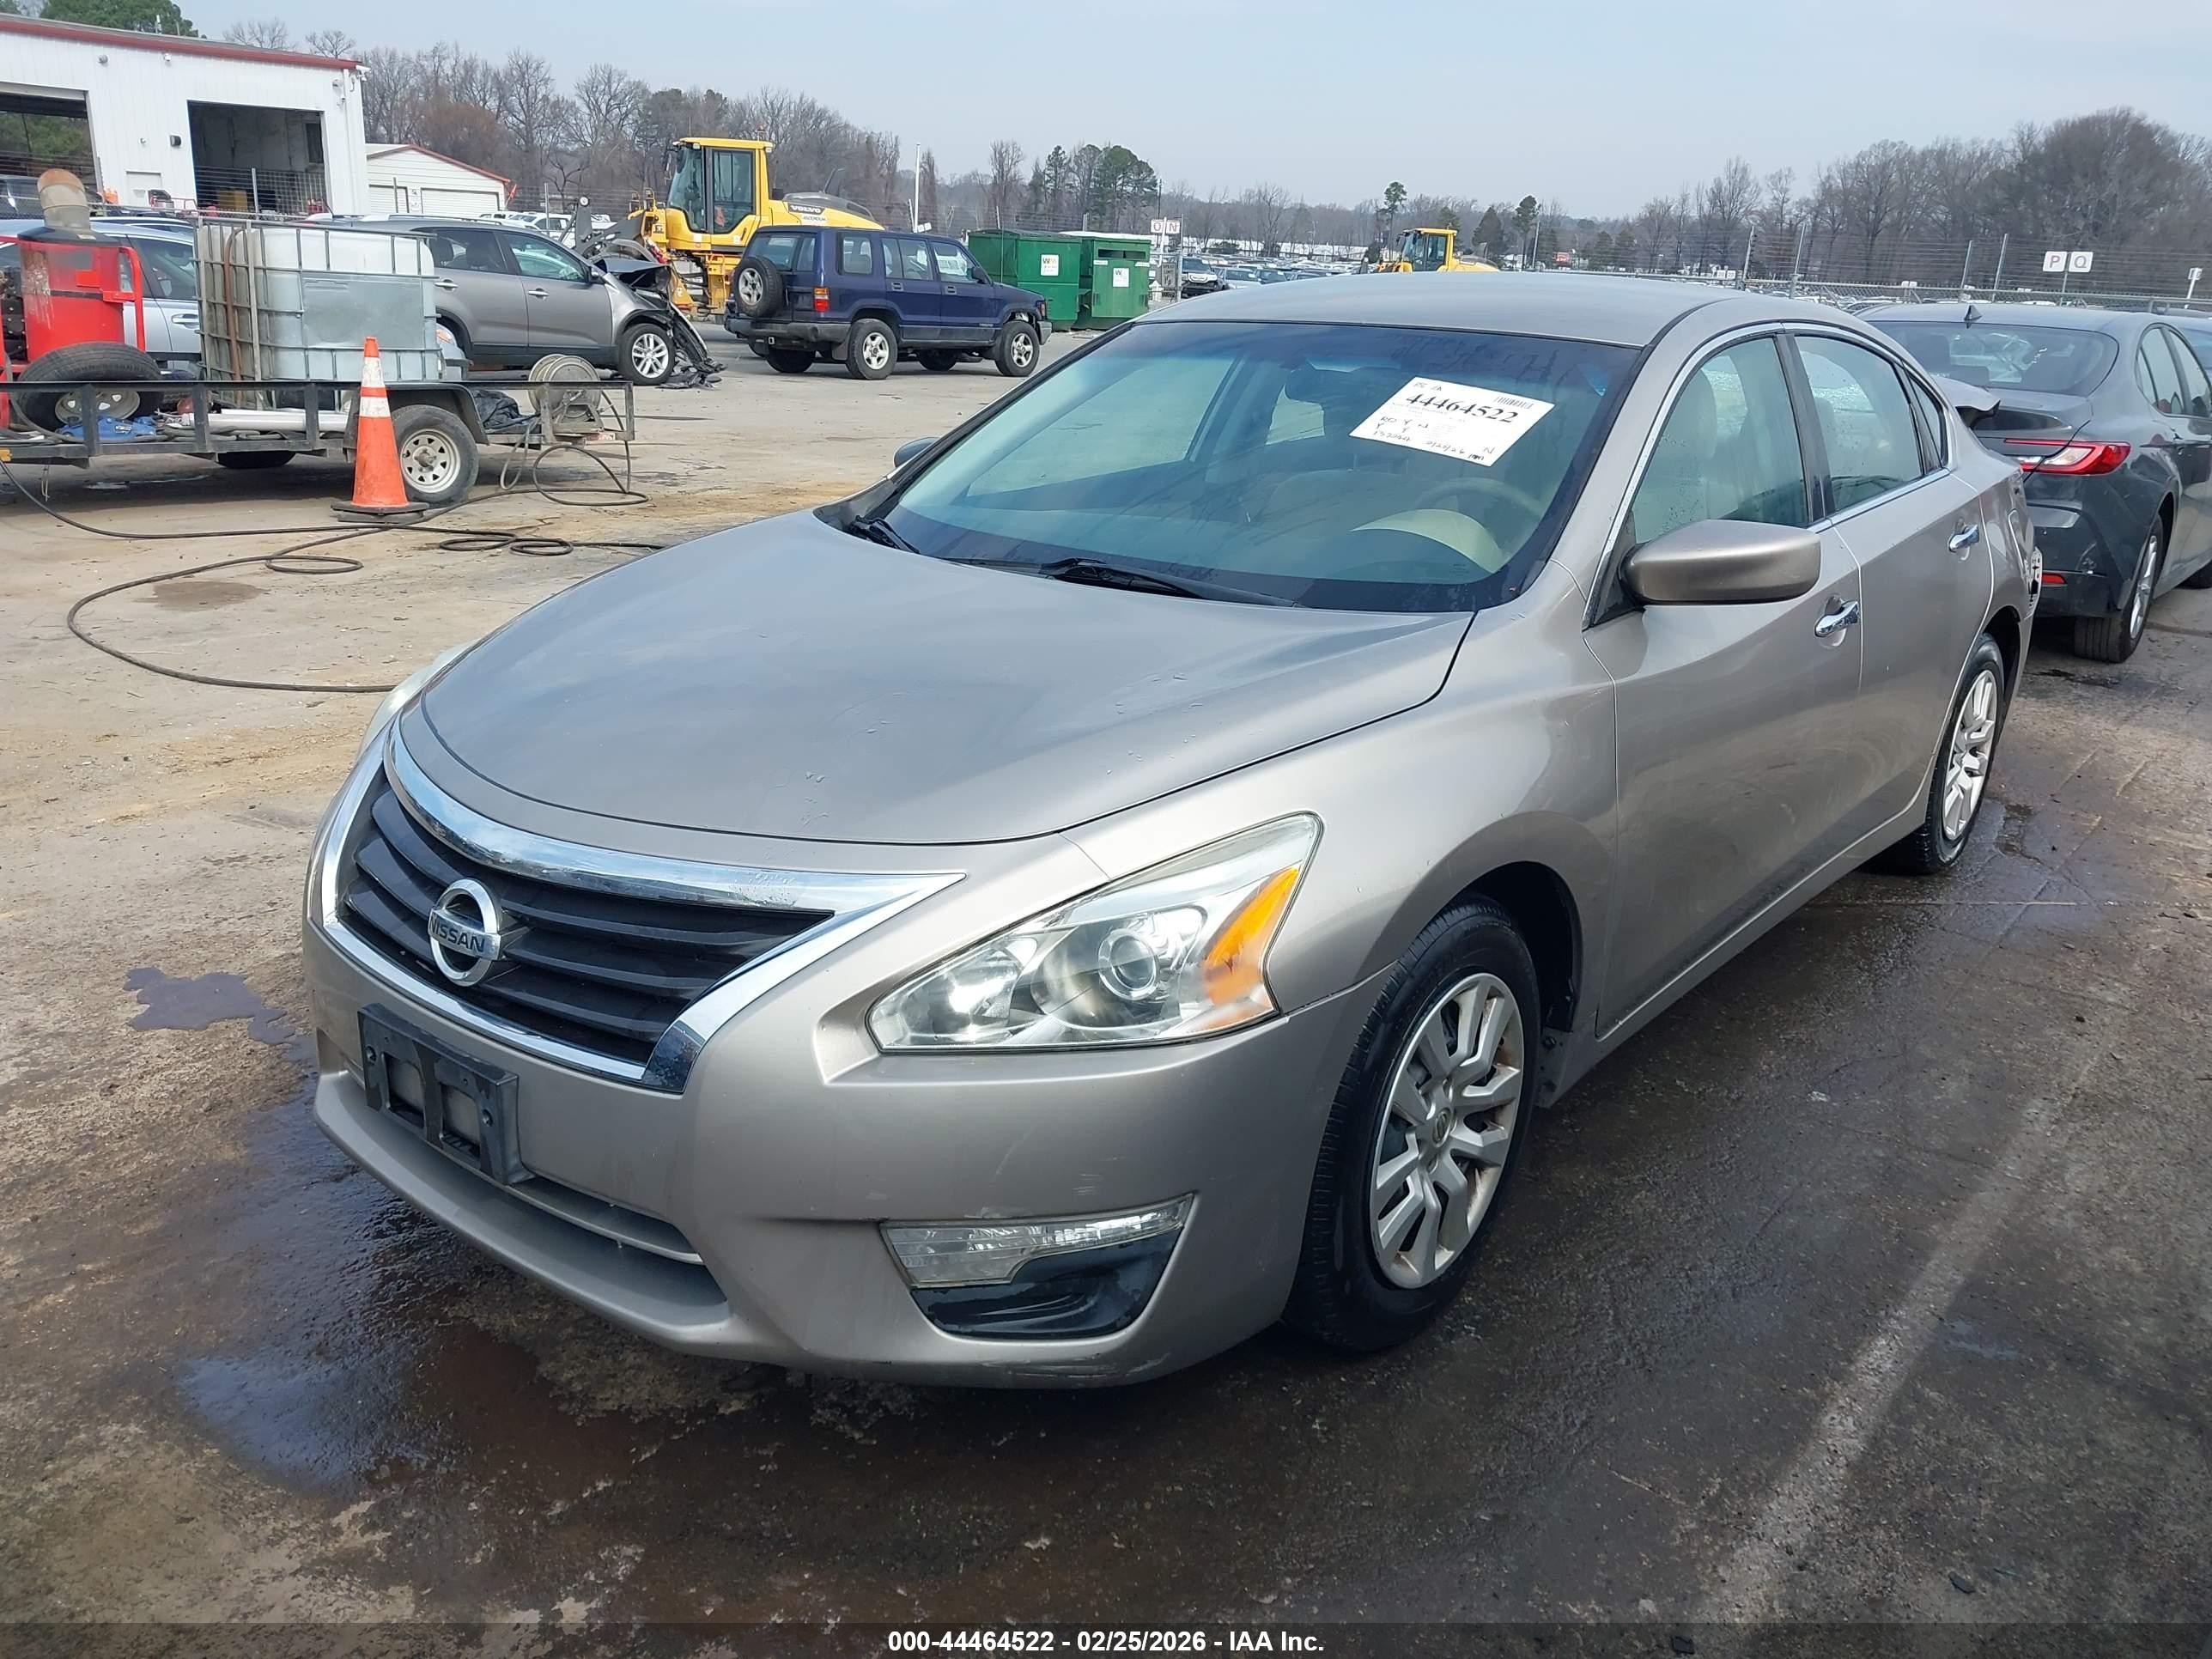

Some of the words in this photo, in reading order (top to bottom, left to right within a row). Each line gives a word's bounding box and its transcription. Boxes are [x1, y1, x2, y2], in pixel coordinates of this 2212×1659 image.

[790, 205, 821, 214] VOLVO
[1169, 222, 1177, 233] N
[2050, 255, 2061, 268] P
[2074, 255, 2087, 269] Q
[1406, 394, 1518, 423] 44464522
[430, 914, 485, 952] NISSAN
